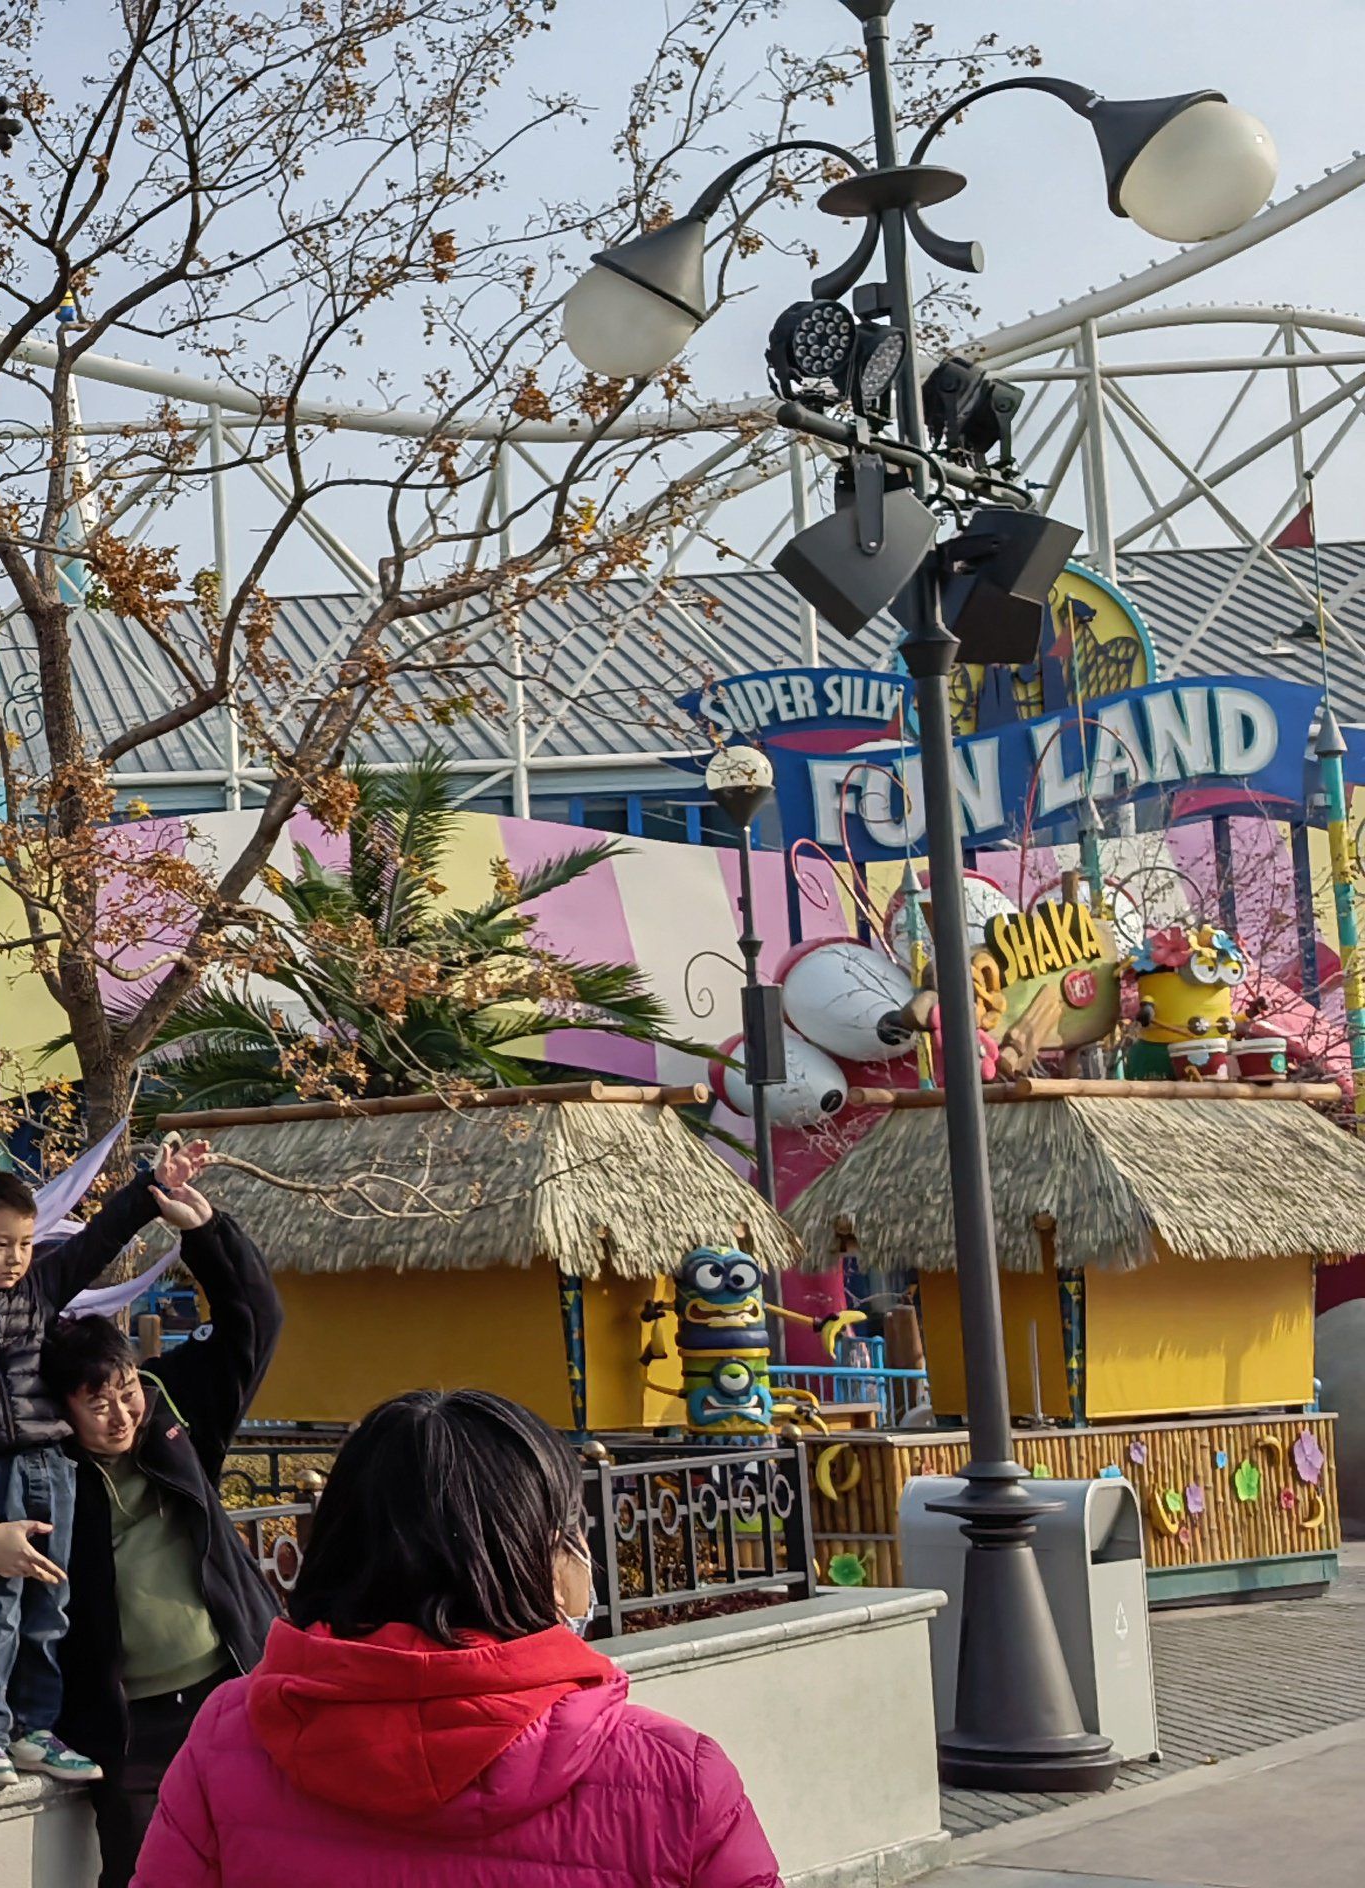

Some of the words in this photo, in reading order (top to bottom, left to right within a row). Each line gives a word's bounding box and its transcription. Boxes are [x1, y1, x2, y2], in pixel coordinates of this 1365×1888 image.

[699, 675, 818, 742] SUPER
[824, 675, 901, 721] SILLY
[807, 736, 1005, 847] FUN
[1031, 687, 1278, 817] LAND
[993, 898, 1100, 986] SHAKA
